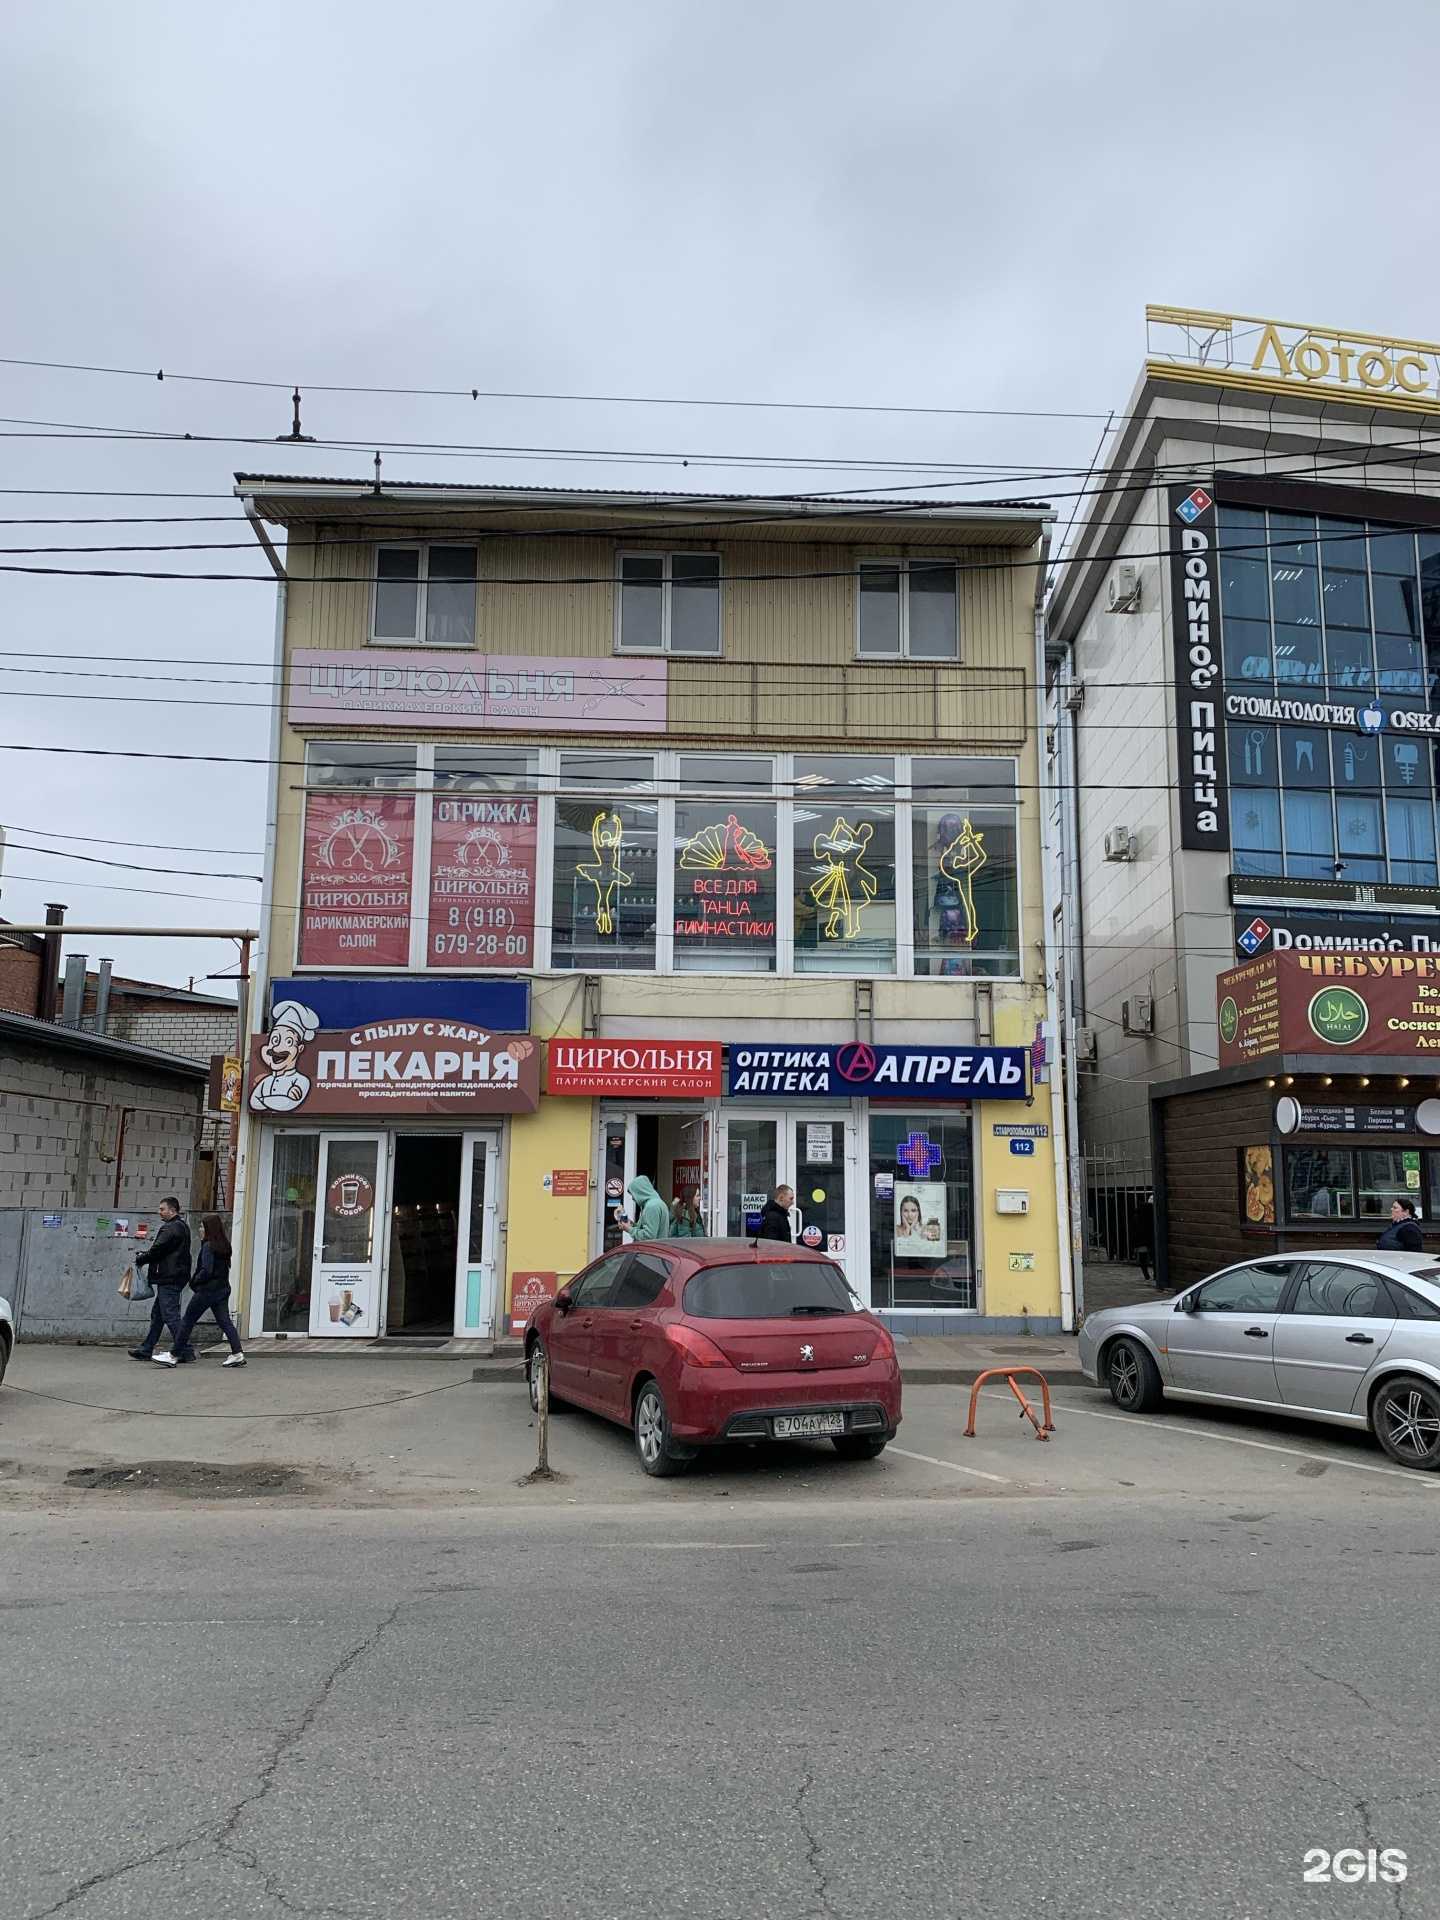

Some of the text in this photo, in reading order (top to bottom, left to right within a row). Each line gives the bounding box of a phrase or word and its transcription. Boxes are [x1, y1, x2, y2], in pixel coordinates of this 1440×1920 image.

[309, 663, 575, 702] ЦИРЮЛЬНЯ
[343, 700, 540, 716] ПАРИКМАХЕРСКИЙ САЛОН
[1226, 695, 1356, 725] СТОМАТОЛОГИЯ
[1190, 701, 1218, 832] Пицца
[438, 802, 530, 823] СТРИЖКА
[433, 880, 528, 895] ЦИРЮЛЬНЯ
[694, 879, 757, 896] ВСЕ ДЛЯ
[306, 892, 408, 907] ЦИРЮЛЬНЯ
[700, 899, 751, 916] ТАНЦА
[306, 913, 409, 929] ПАРИКМАХЕРСКИЙ
[448, 906, 515, 933] 8 (918)
[675, 920, 774, 936] ГИМНАСТИКИ
[339, 934, 377, 947] САЛОН
[435, 933, 527, 955] 679-28-60
[1418, 985, 1440, 997] Бе
[350, 1023, 491, 1046] С ПЫЛУ С ЖАРУ
[317, 1051, 519, 1080] ПЕКАРНЯ
[556, 1047, 712, 1071] ЦИРЮЛЬНЯ
[736, 1051, 830, 1067] ОПТИКА
[874, 1055, 1022, 1084] АПРЕЛЬ
[316, 1081, 351, 1090] горячая
[353, 1081, 394, 1089] выпечка,
[395, 1081, 456, 1089] кондитерские
[556, 1077, 712, 1088] ПАРИКМАХЕРСКИЙ САЛОН
[734, 1071, 829, 1091] АПТЕКА
[359, 1090, 438, 1098] прохладительные
[1015, 1143, 1031, 1151] 112
[675, 1166, 700, 1185] СТРИЖК
